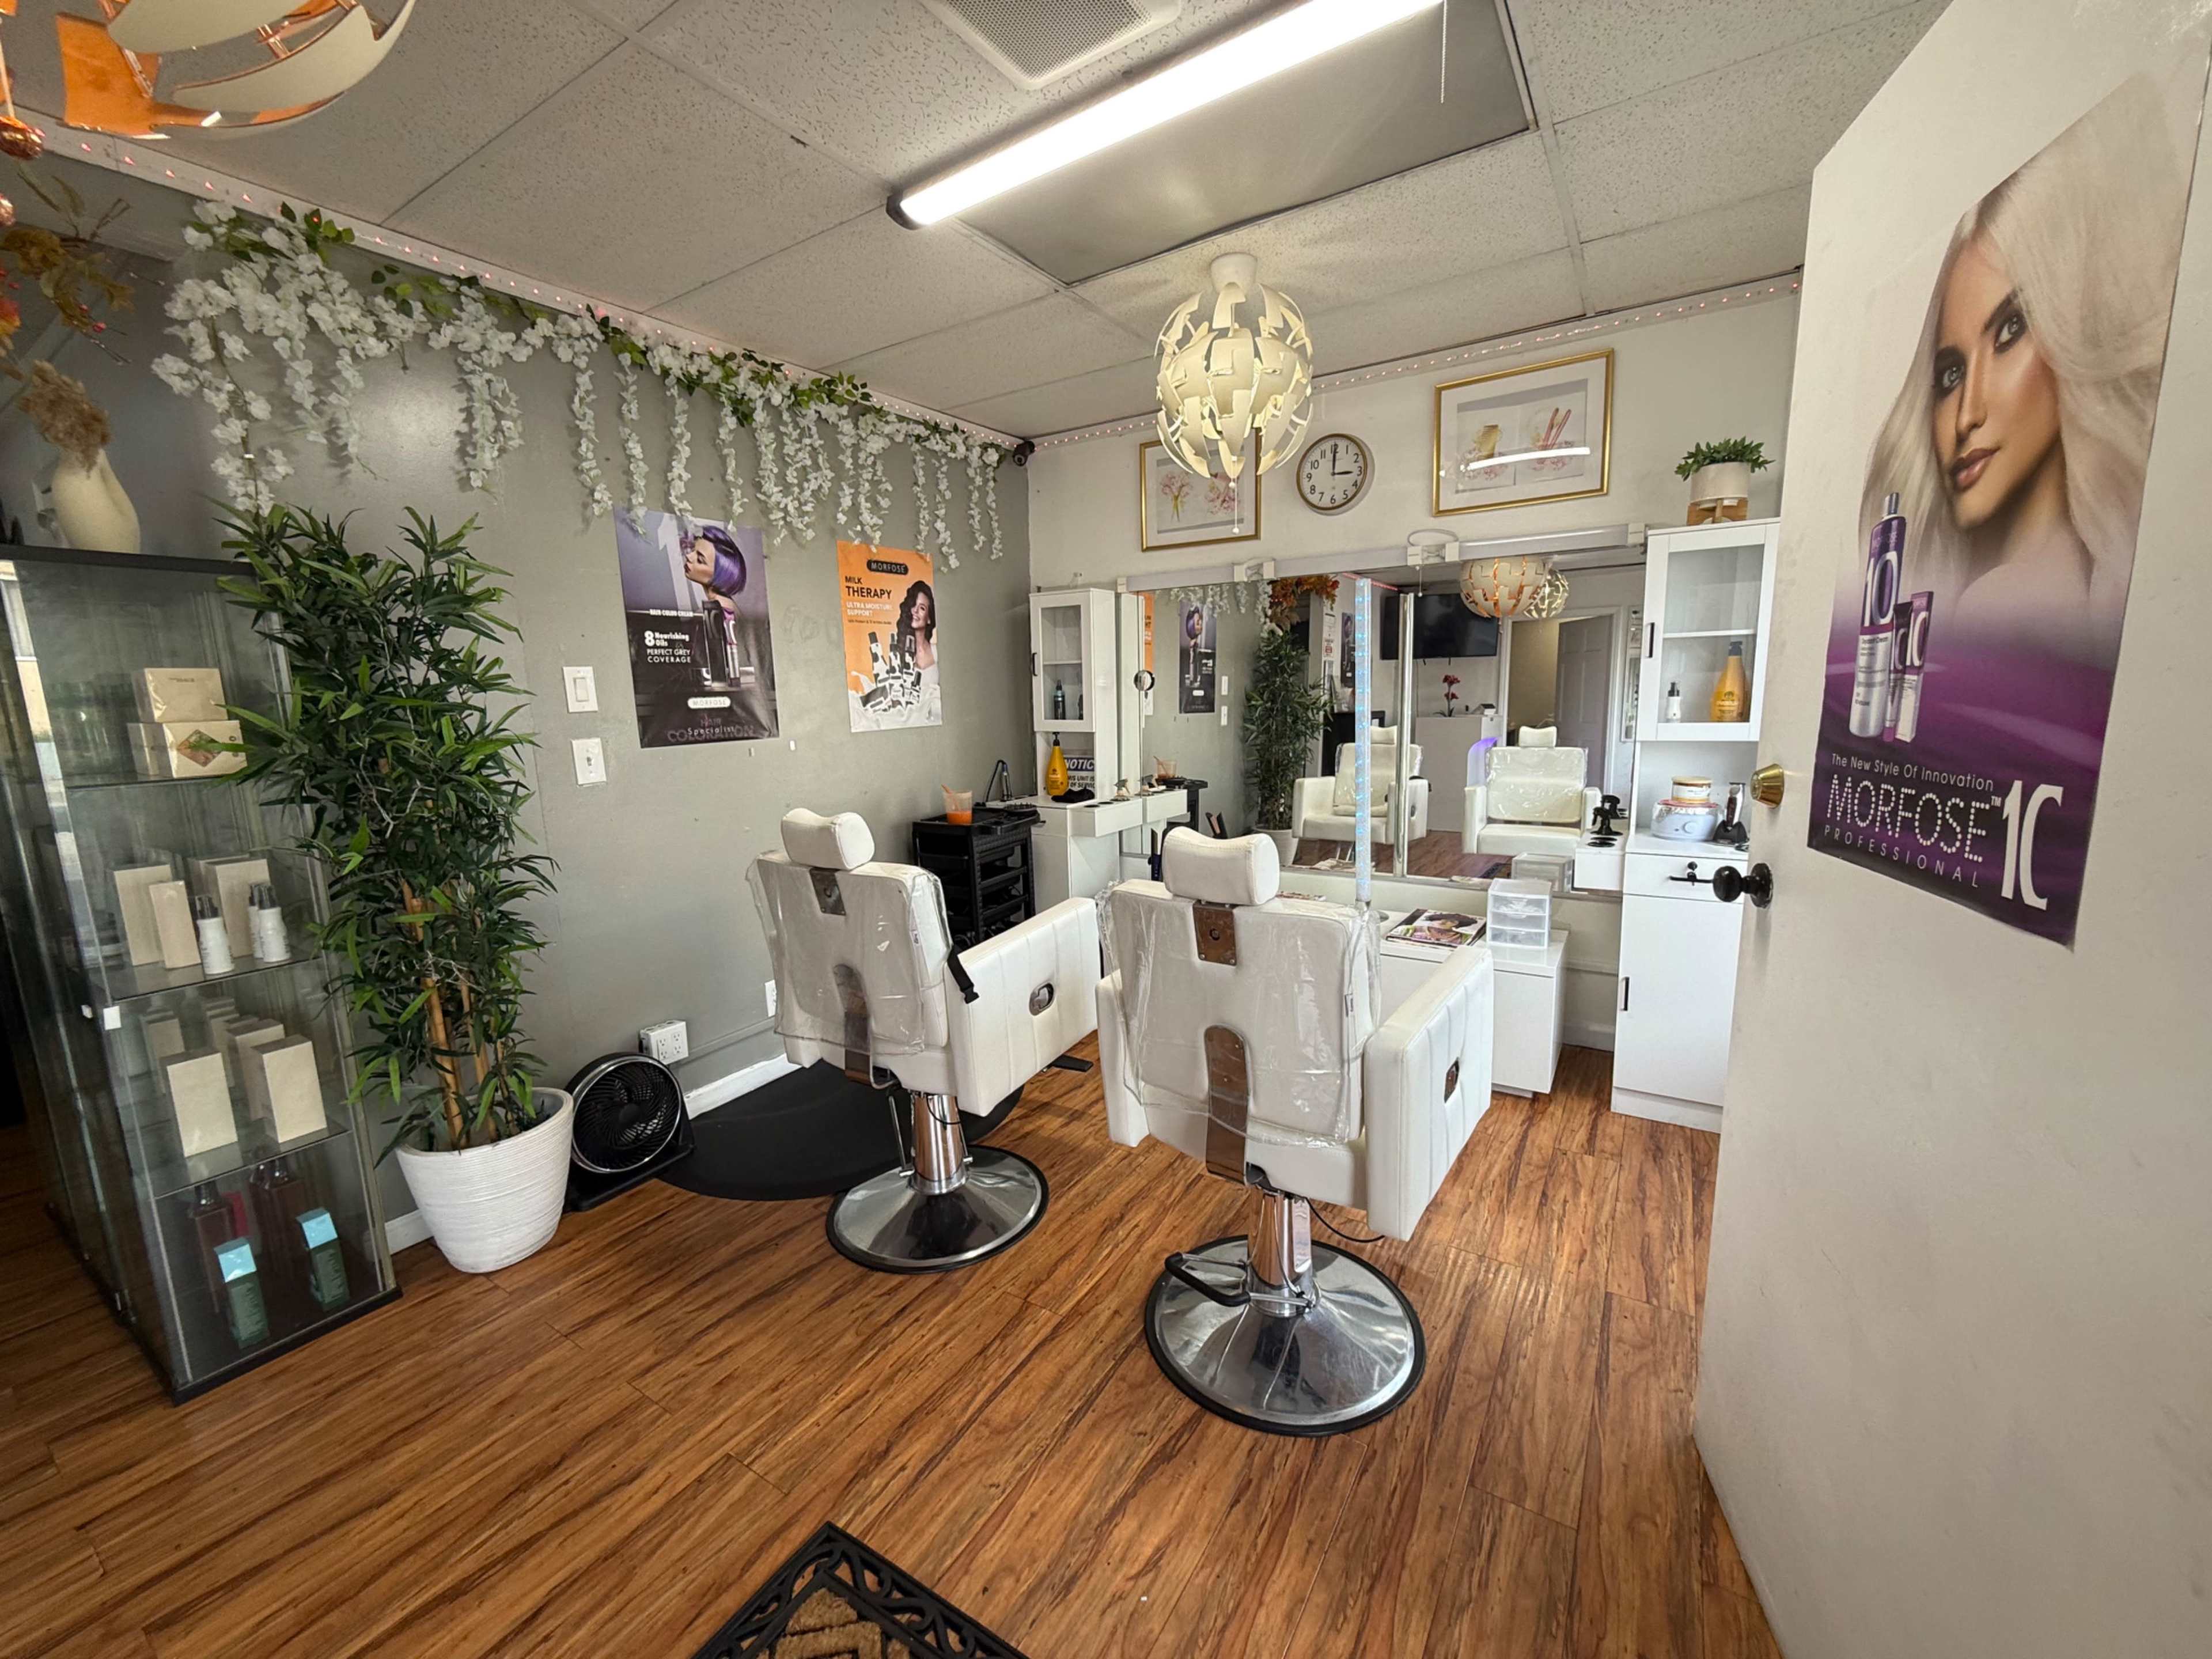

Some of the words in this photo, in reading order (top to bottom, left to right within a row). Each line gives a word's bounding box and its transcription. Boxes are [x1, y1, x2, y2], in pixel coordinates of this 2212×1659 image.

[1320, 449, 1326, 460] 11
[1353, 453, 1359, 463] 2
[1310, 460, 1319, 470] 10
[1357, 466, 1362, 476] 3
[1306, 472, 1312, 482] 9
[1352, 479, 1358, 489] 4
[1309, 484, 1316, 495] 8
[1342, 490, 1349, 499] 5
[1318, 491, 1324, 502] 7
[1330, 494, 1336, 504] 6
[870, 562, 906, 573] MORFOSE
[844, 575, 863, 585] MILK
[846, 585, 892, 600] THERAPY
[644, 630, 655, 647] 8
[655, 631, 690, 642] Nourishing
[656, 639, 668, 647] Oils
[1832, 753, 1847, 768] The
[1850, 756, 1870, 772] New
[1874, 759, 1899, 777] Style
[1903, 764, 1919, 779] Of
[1921, 769, 1994, 792] Innovation
[1826, 774, 1990, 863] MORFOSE
[1824, 824, 1979, 888] PROFESSIONAL
